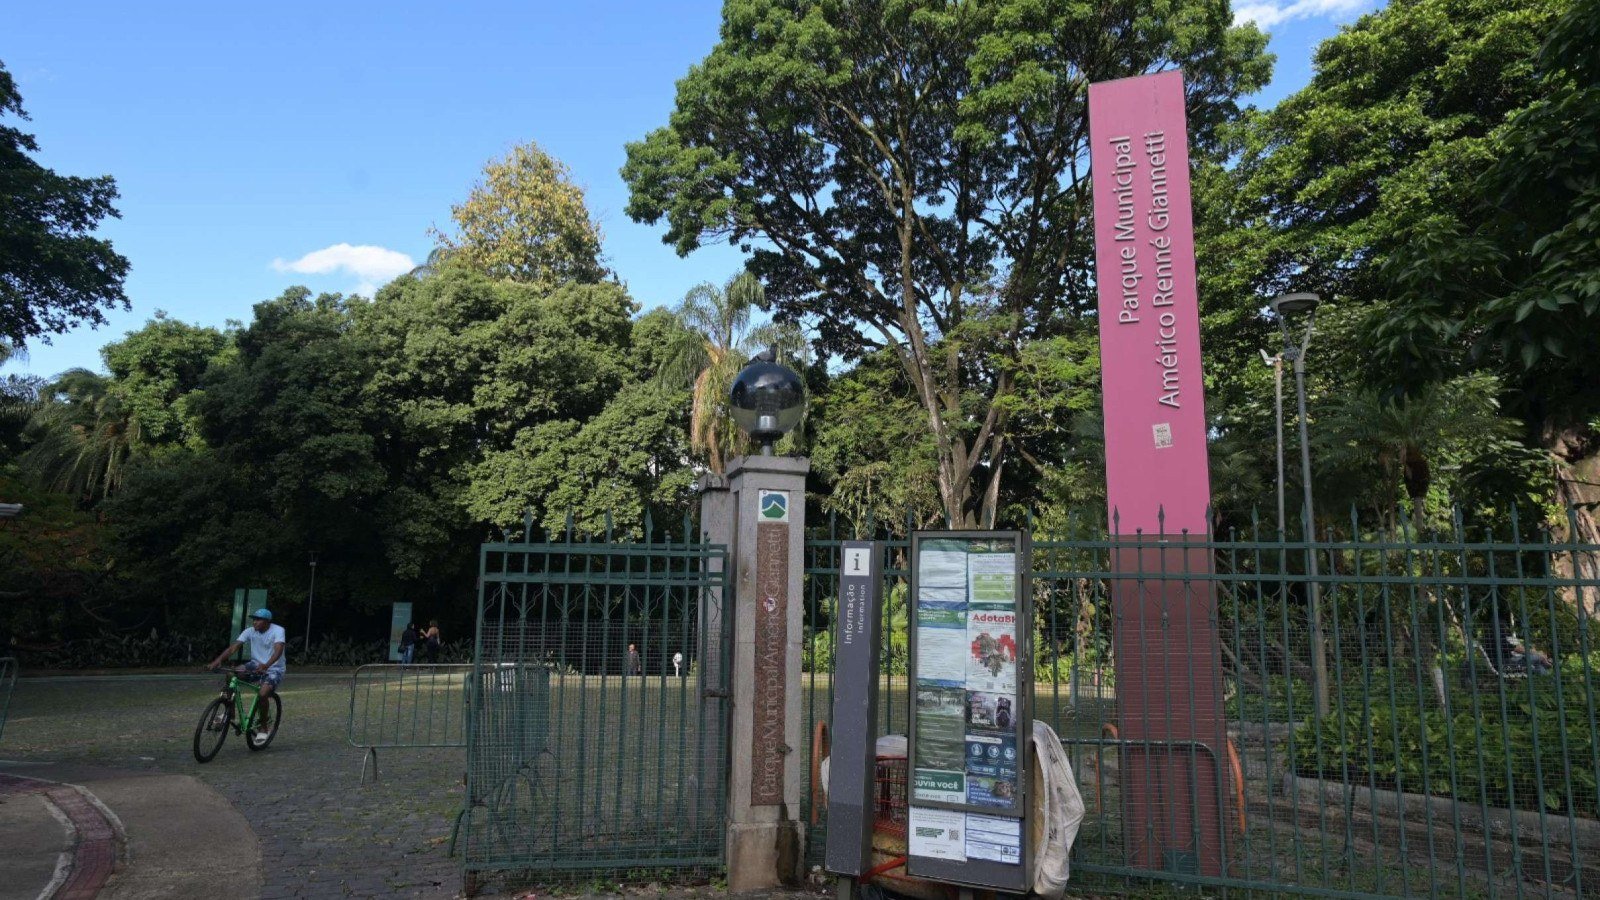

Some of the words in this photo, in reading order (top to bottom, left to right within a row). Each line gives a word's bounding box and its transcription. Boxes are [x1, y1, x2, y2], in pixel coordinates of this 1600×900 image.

[1109, 136, 1137, 242] Municipal
[1144, 131, 1169, 231] Giannetti
[1118, 246, 1143, 325] Parque
[1149, 236, 1174, 308] Renné
[1154, 312, 1180, 409] Américo
[844, 583, 855, 644] Informação
[858, 584, 866, 634] Information
[762, 665, 782, 740] Municipal
[760, 742, 782, 797] Parque
